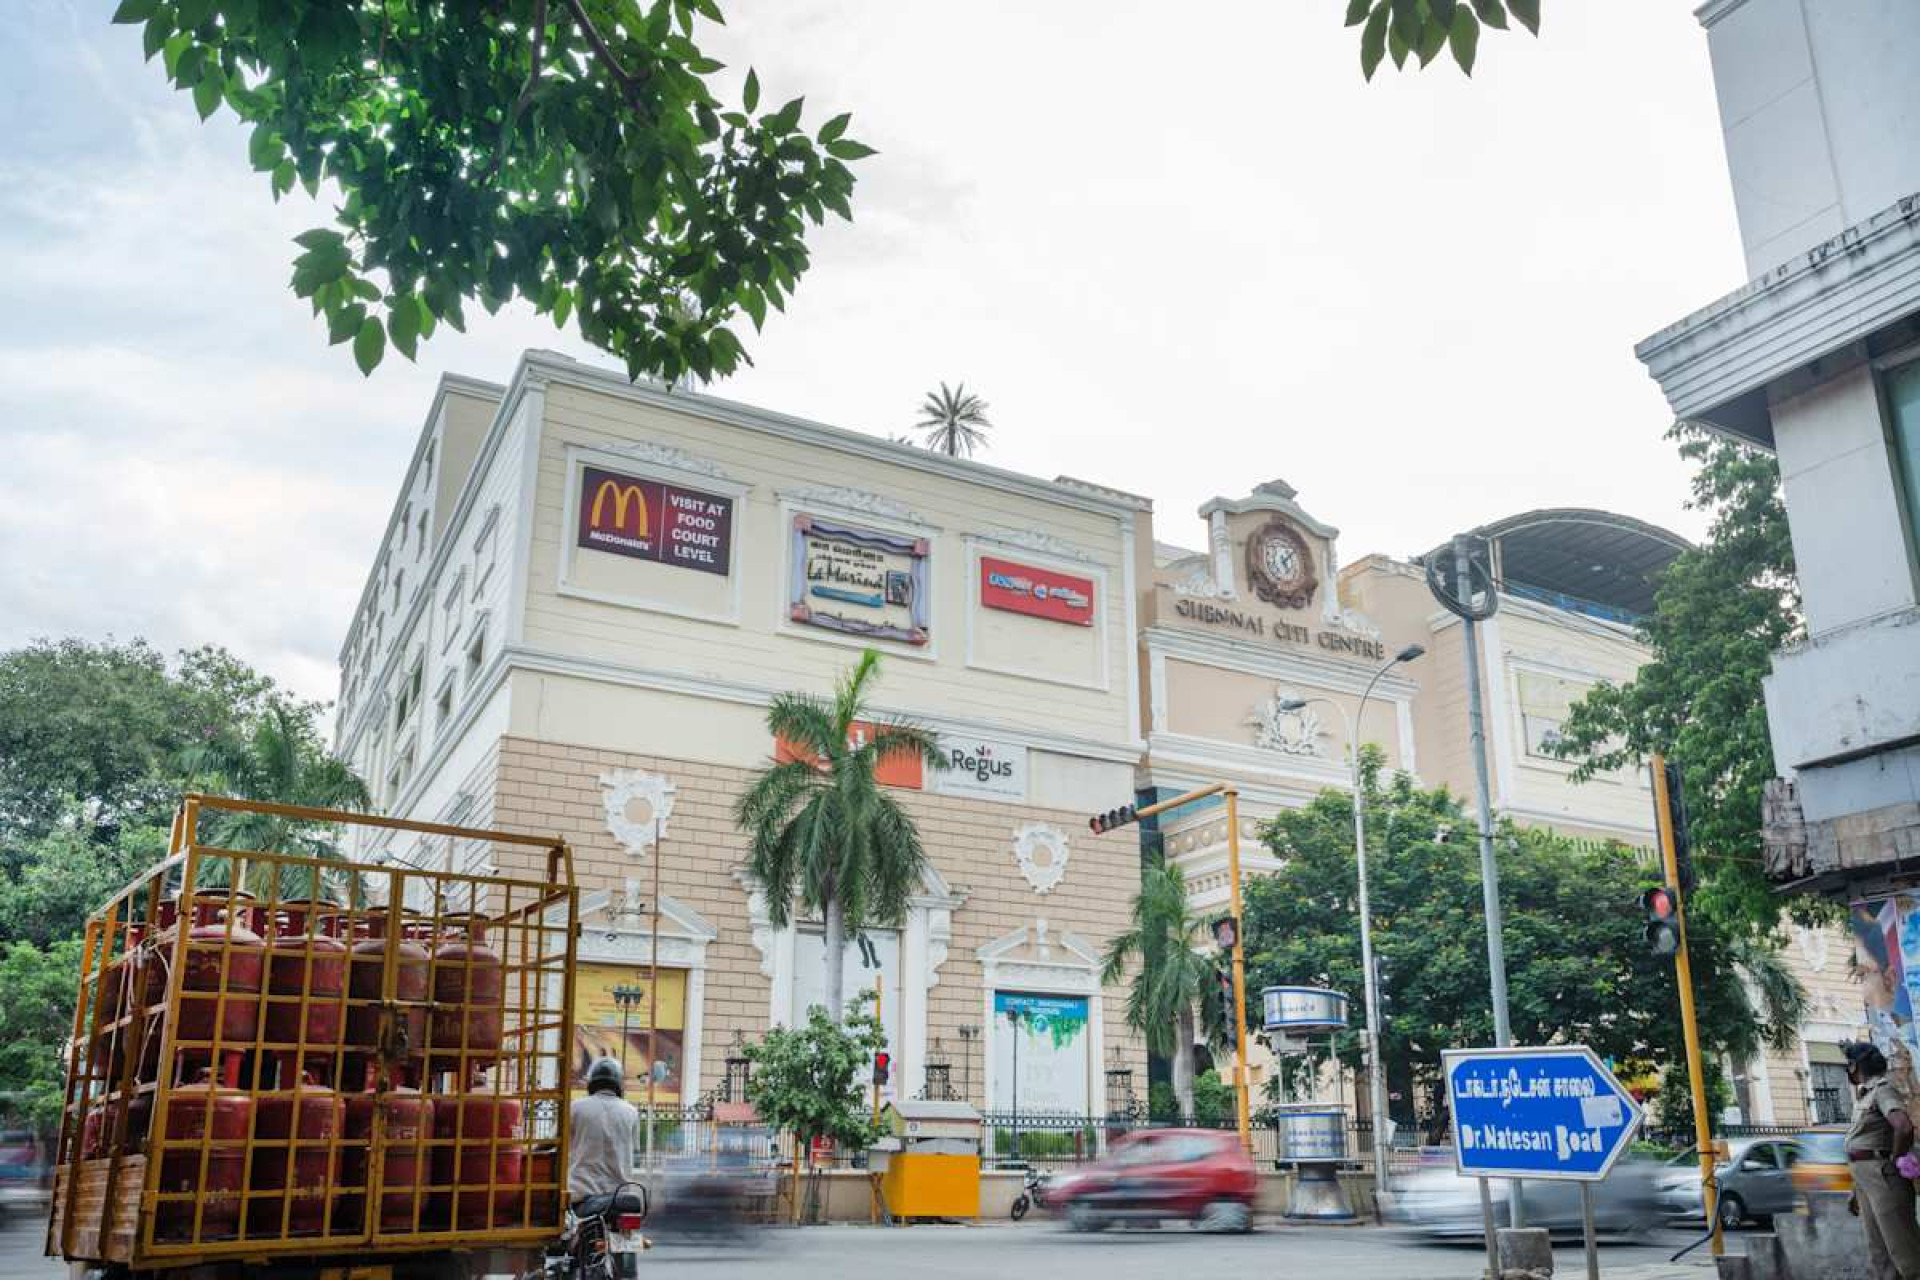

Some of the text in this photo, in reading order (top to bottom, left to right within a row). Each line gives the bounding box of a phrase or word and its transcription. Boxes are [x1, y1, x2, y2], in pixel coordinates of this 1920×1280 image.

[670, 493, 725, 517] VISIT AT
[677, 512, 715, 530] FOOD
[671, 528, 720, 548] COURT
[674, 544, 715, 563] LEVEL
[1175, 599, 1385, 660] CHENNAI CITI CENTRE
[951, 749, 1012, 782] Regus
[1461, 1124, 1552, 1151] Dr.Natesan
